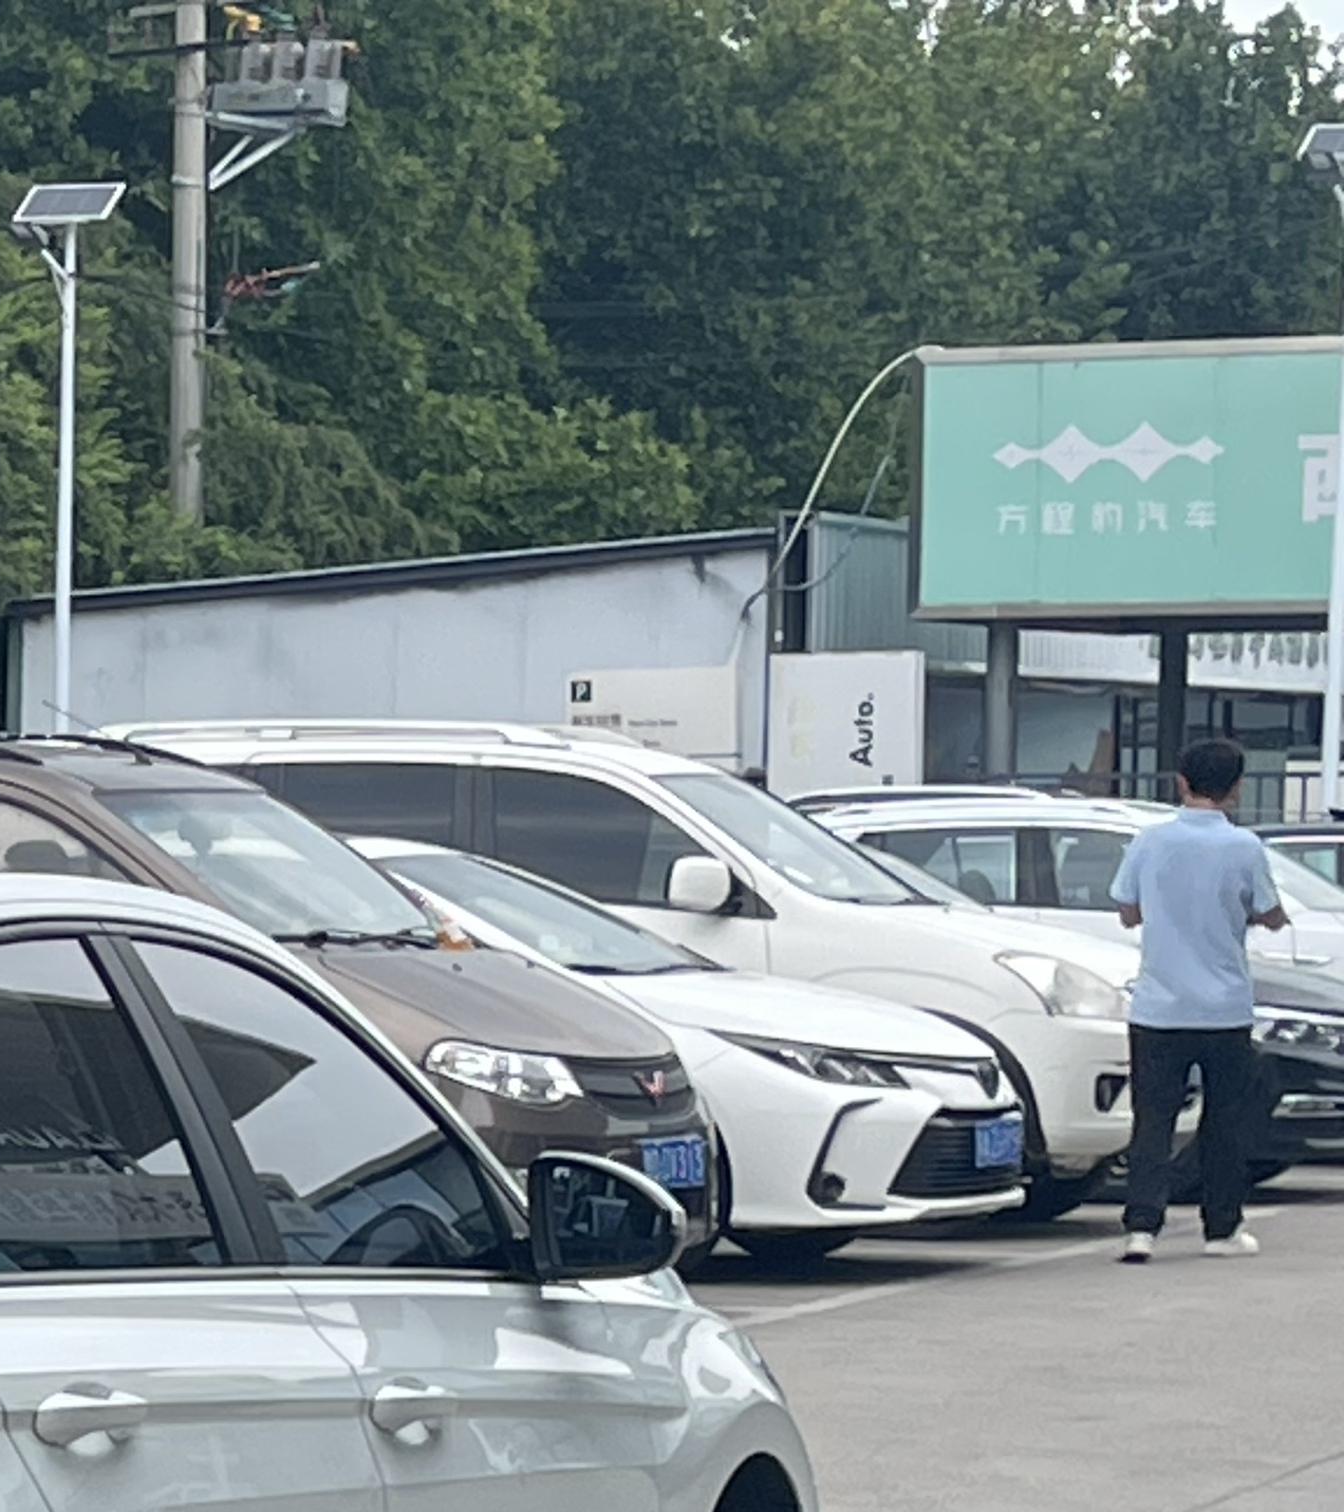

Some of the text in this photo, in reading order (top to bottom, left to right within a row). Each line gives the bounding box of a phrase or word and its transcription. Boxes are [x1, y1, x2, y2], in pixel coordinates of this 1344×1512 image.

[996, 499, 1217, 535] 方程豹汽车
